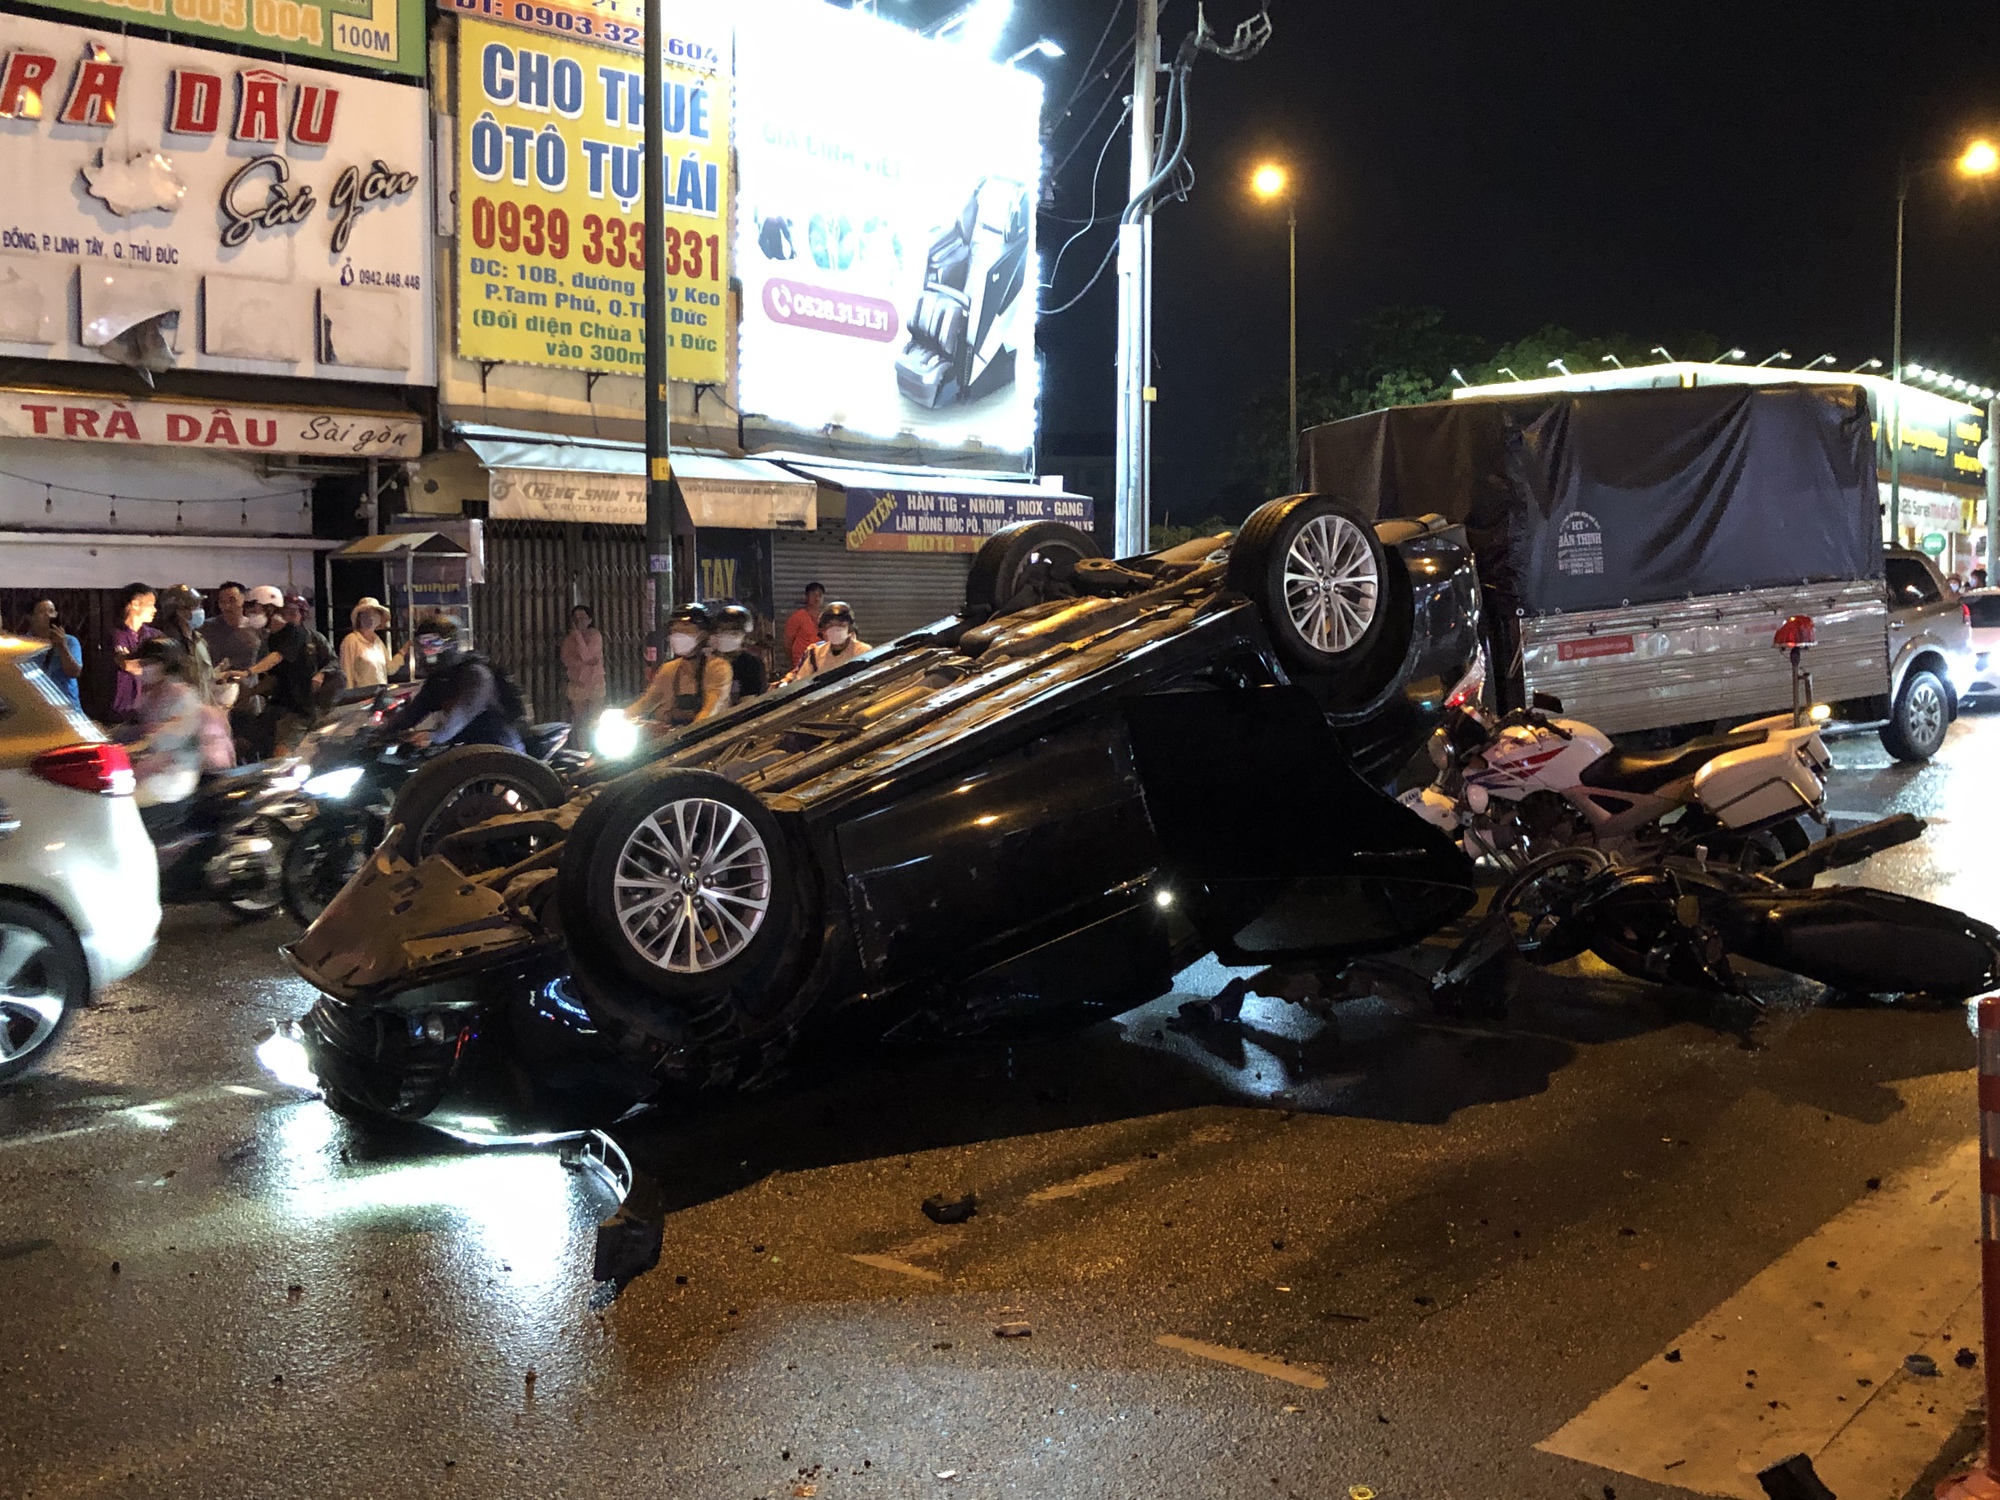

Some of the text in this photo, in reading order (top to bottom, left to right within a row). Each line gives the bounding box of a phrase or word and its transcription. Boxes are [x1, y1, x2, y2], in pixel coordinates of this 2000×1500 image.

[337, 23, 391, 53] 100M
[170, 69, 340, 146] DÂU
[483, 43, 709, 140] CHO THUÊ
[472, 112, 718, 213] ÔTÔ TỰ LÁI
[221, 154, 419, 254] Sài gòn
[472, 196, 570, 260] 0939
[55, 236, 80, 255] LINH
[130, 240, 152, 263] THỦ
[156, 242, 180, 265] ĐỨC
[359, 268, 421, 291] 0942.448.448
[470, 257, 509, 279] ĐC:
[517, 264, 564, 287] 10B,
[572, 271, 635, 297] đường
[685, 287, 721, 306] Keo
[485, 283, 547, 307] P.Tam
[555, 292, 602, 316] Phú,
[671, 307, 708, 327] Đức
[473, 309, 518, 329] (Đối
[526, 315, 572, 339] diện
[580, 321, 632, 343] Chùa
[681, 333, 718, 352] Đức
[546, 340, 583, 358] vào
[21, 401, 408, 452] TRÀ DÂU Sài gòn
[895, 512, 917, 532] LÀM
[945, 515, 965, 533] MÓC
[907, 491, 935, 513] HÀN
[938, 495, 958, 512] TIG
[1016, 500, 1044, 516] INOX
[1053, 501, 1084, 517] GANG
[1571, 520, 1584, 531] HT
[700, 558, 736, 600] TAY
